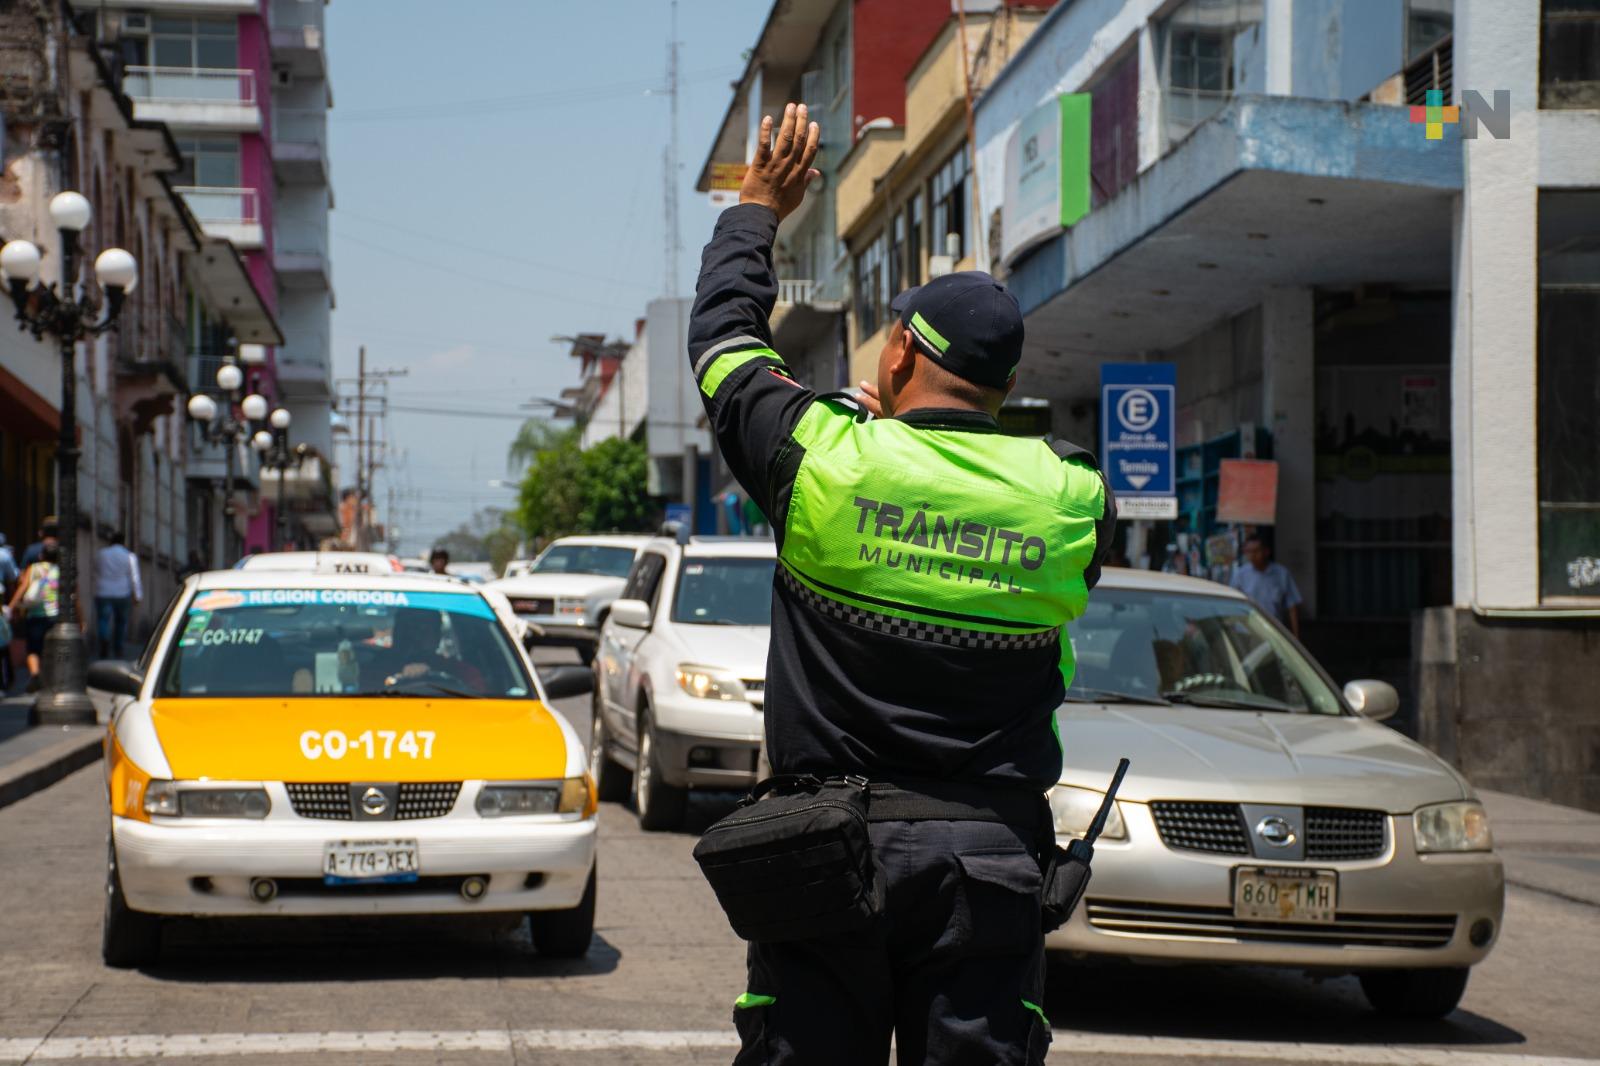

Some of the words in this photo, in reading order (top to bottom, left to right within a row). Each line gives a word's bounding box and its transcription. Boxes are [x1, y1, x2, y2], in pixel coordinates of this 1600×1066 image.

[1127, 398, 1148, 422] E
[1119, 459, 1159, 474] Termina
[334, 563, 369, 573] TAXI
[858, 543, 1022, 594] MUNICIPAL
[249, 590, 317, 604] REGION
[320, 591, 408, 606] CORDOBA
[202, 629, 263, 646] CO-1747
[299, 729, 436, 760] CO-1747
[328, 851, 415, 872] A-774-XEX
